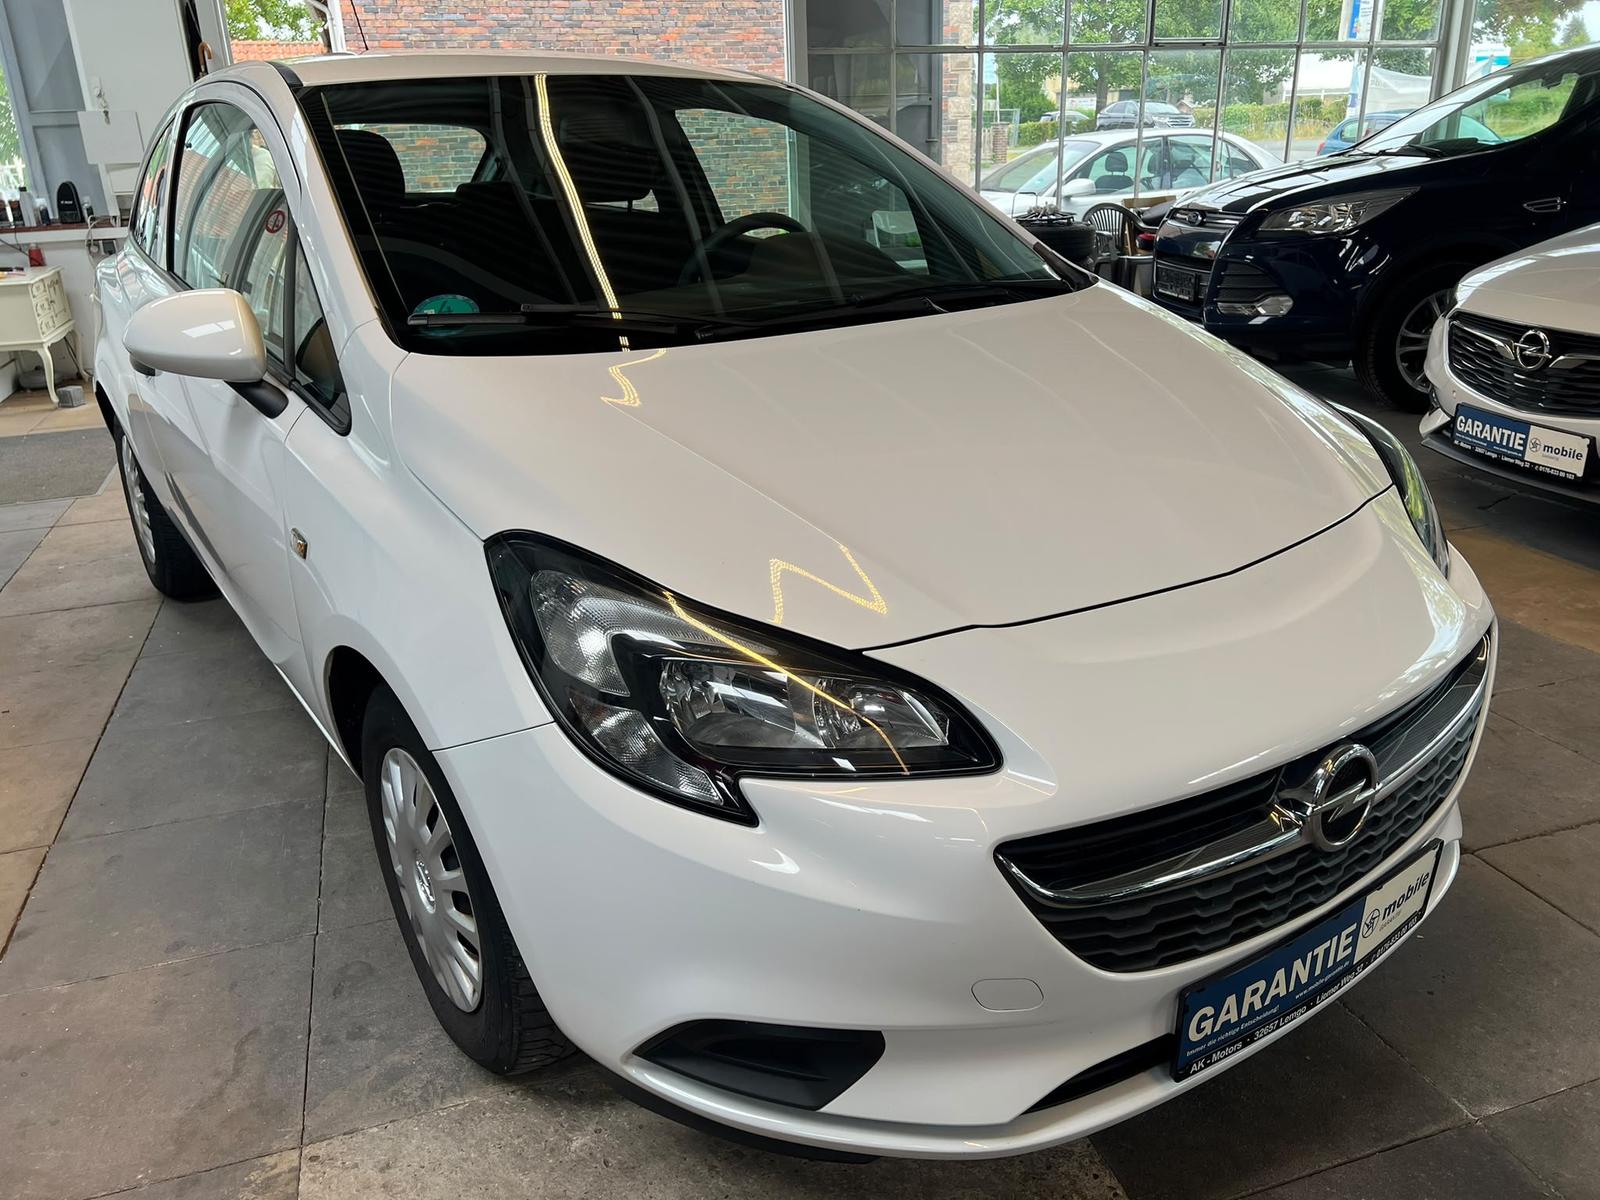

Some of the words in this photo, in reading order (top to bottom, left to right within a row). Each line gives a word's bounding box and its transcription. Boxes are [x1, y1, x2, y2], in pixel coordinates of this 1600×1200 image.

[1456, 415, 1527, 451] GARANTIE
[1542, 443, 1584, 461] mobile
[1381, 870, 1430, 921] mobile
[1188, 921, 1357, 1042] GARANTIE
[1186, 1044, 1206, 1057] Immer
[1207, 1038, 1217, 1047] die
[1217, 1027, 1240, 1043] richtige
[1190, 1059, 1205, 1074] AK
[1211, 1041, 1243, 1063] Motors
[1253, 1019, 1278, 1041] 32657
[1279, 1005, 1307, 1027] Lemgo
